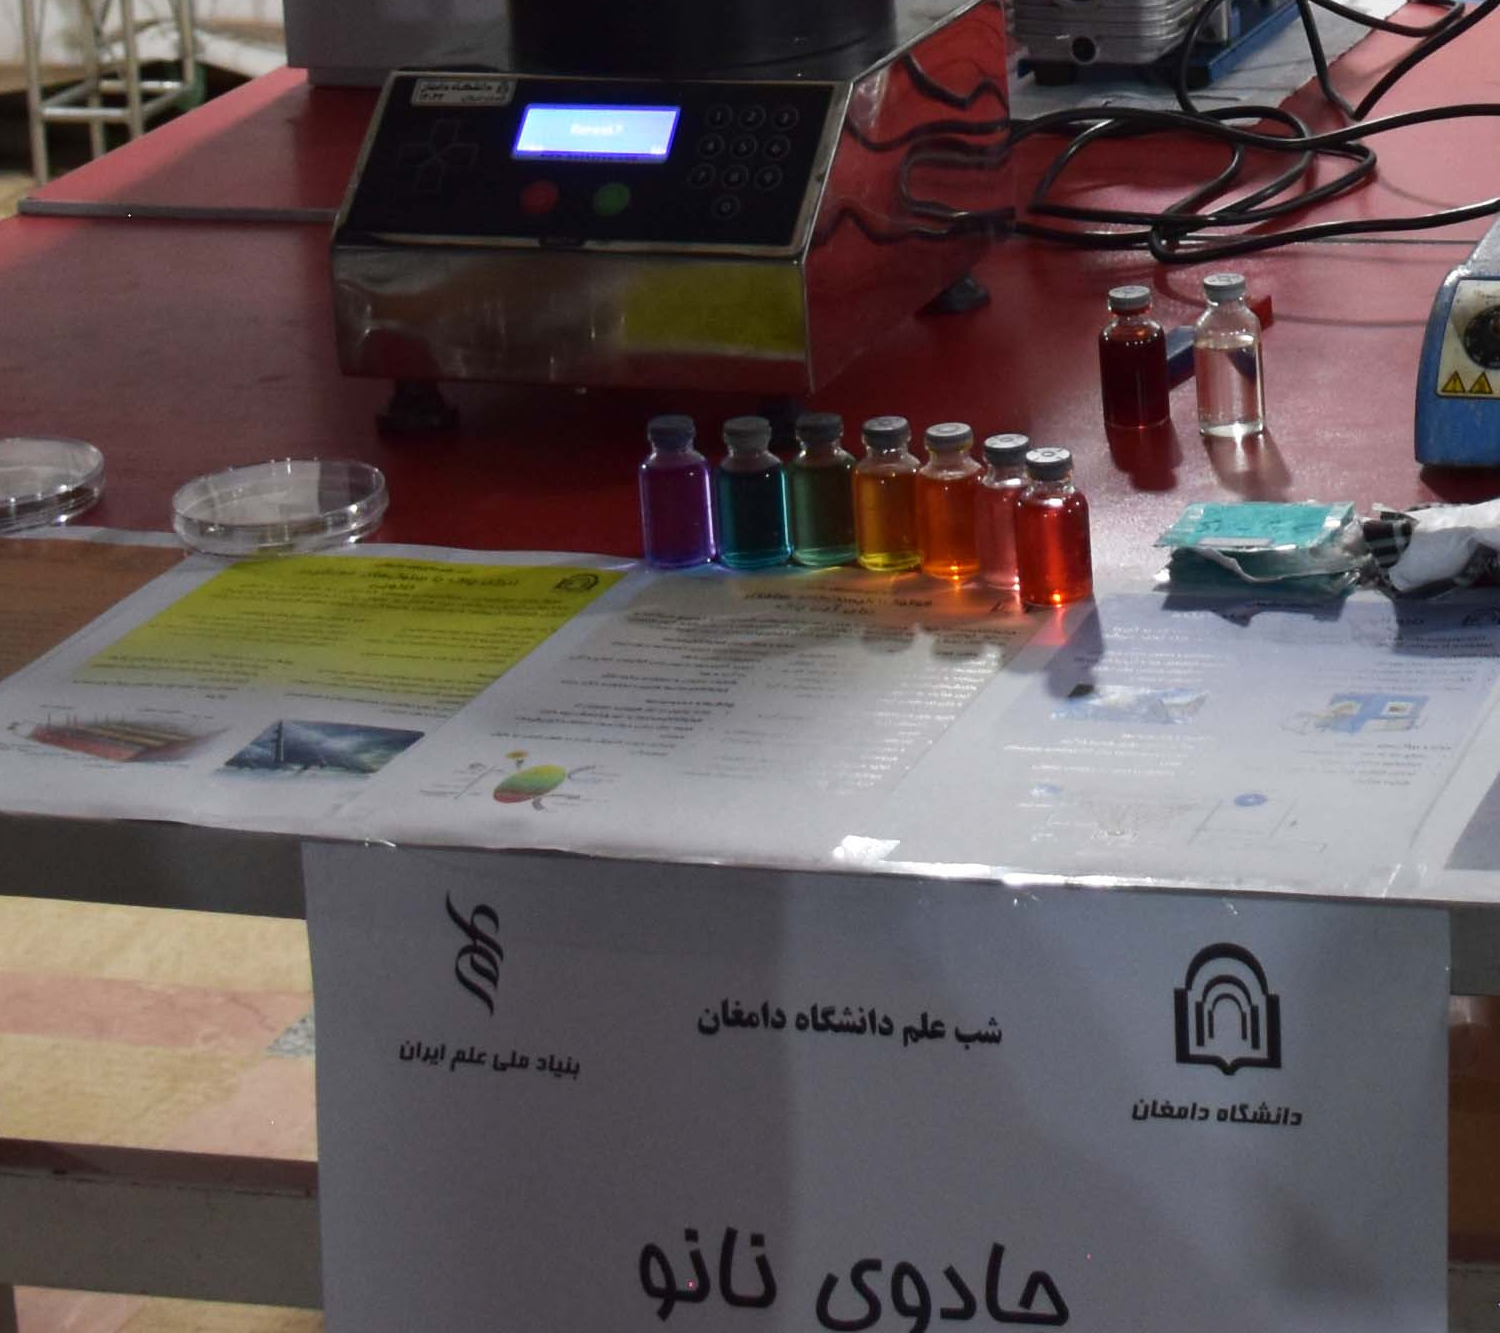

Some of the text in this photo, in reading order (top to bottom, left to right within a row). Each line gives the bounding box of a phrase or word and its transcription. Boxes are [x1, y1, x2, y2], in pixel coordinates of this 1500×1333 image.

[696, 997, 1003, 1051] شب علم دانشگاه دامغان
[398, 1039, 581, 1081] بنیاد ملی علم ایران
[1131, 1098, 1303, 1127] دانشگاه دامغان
[638, 1226, 778, 1323] نانو
